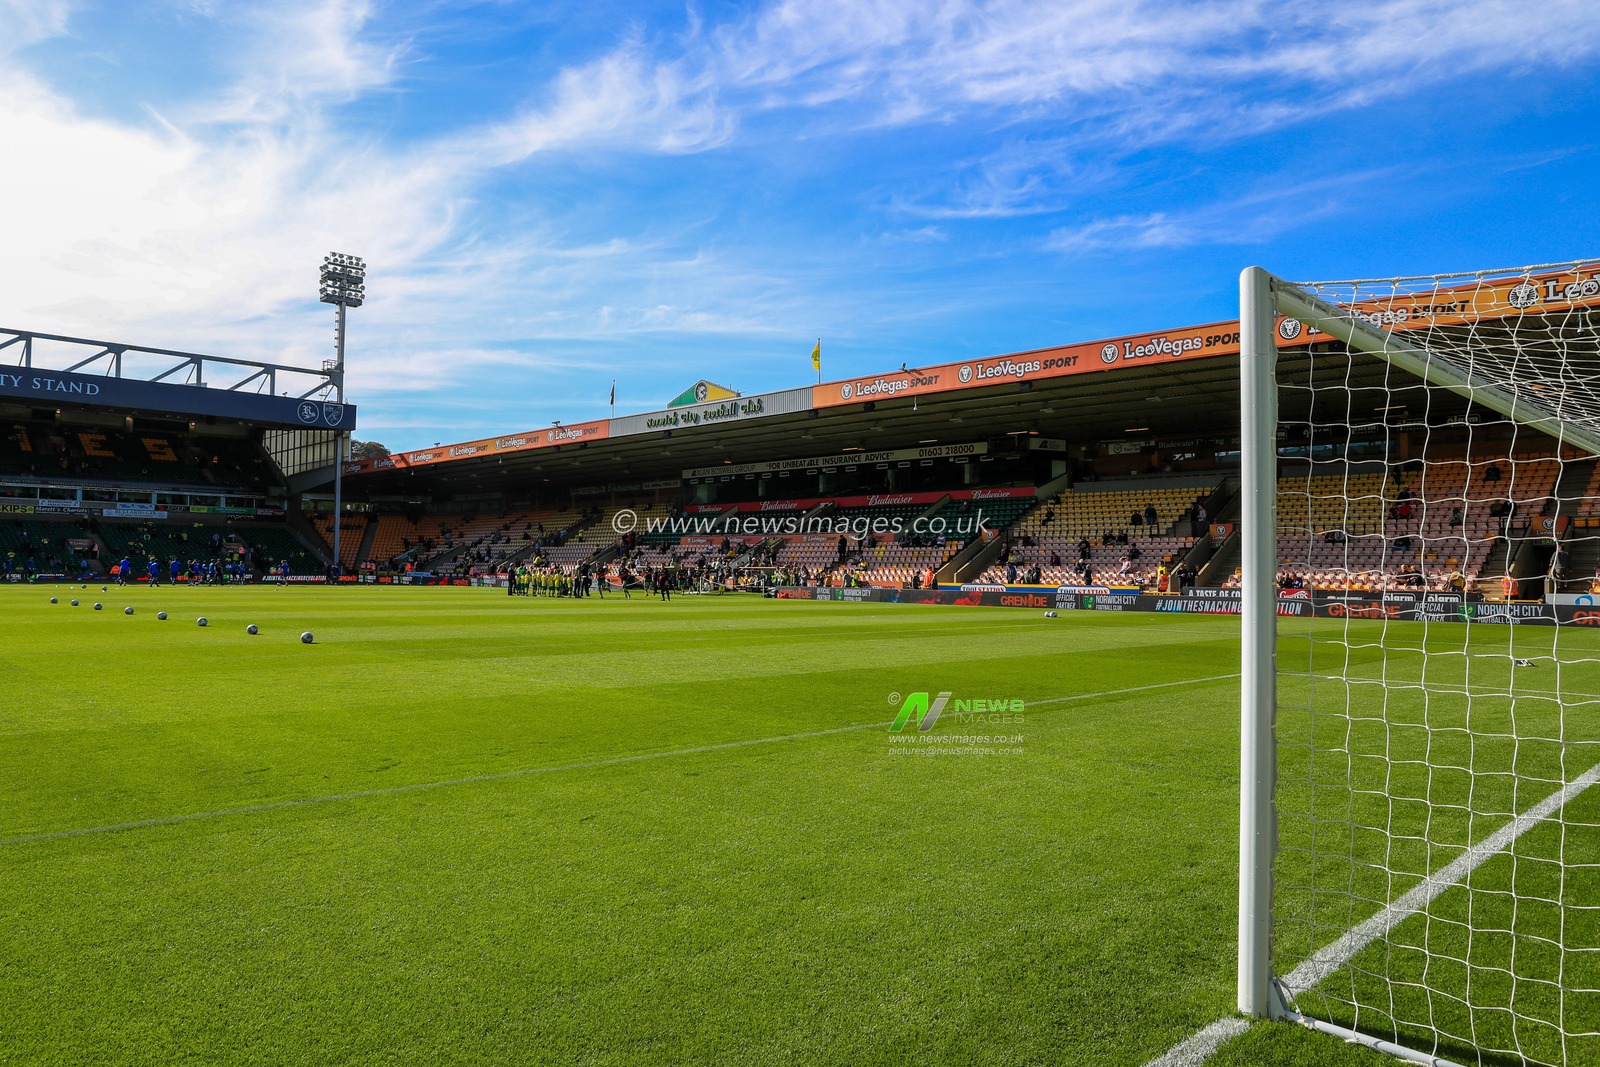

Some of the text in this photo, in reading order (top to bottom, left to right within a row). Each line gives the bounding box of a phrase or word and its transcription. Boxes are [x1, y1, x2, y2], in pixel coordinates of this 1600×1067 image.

[1543, 273, 1600, 302] Leo
[1412, 300, 1470, 320] SPORT
[1124, 332, 1240, 360] LeoVegas SPOR
[976, 355, 1079, 380] LeoVegas SPORT
[32, 378, 100, 395] STAND
[856, 375, 940, 397] LeoVegas SPORT
[646, 399, 761, 428] Norwich City Football Club
[555, 427, 599, 440] LeoVegas SPORT
[502, 436, 540, 448] LeoVegas SPORT
[414, 453, 433, 462] LeoVegas
[455, 446, 477, 457] LeoVegas
[822, 454, 862, 465] INSURANCE
[919, 448, 943, 457] 01603
[945, 444, 975, 455] 218000
[711, 467, 734, 475] BOSWELL
[867, 494, 913, 506] Budweiser
[971, 490, 1010, 500] Budweiser
[0, 505, 27, 513] KIPS
[760, 500, 798, 511] Budweiser
[862, 589, 871, 597] CITY
[1056, 594, 1076, 602] OFFICIAL
[1000, 594, 1048, 608] GRENADE
[1056, 602, 1076, 610] PARTNER
[1095, 595, 1137, 605] NORWICH CITY
[1328, 602, 1400, 618] GRENADE
[1477, 605, 1544, 617] NORWICH CITY
